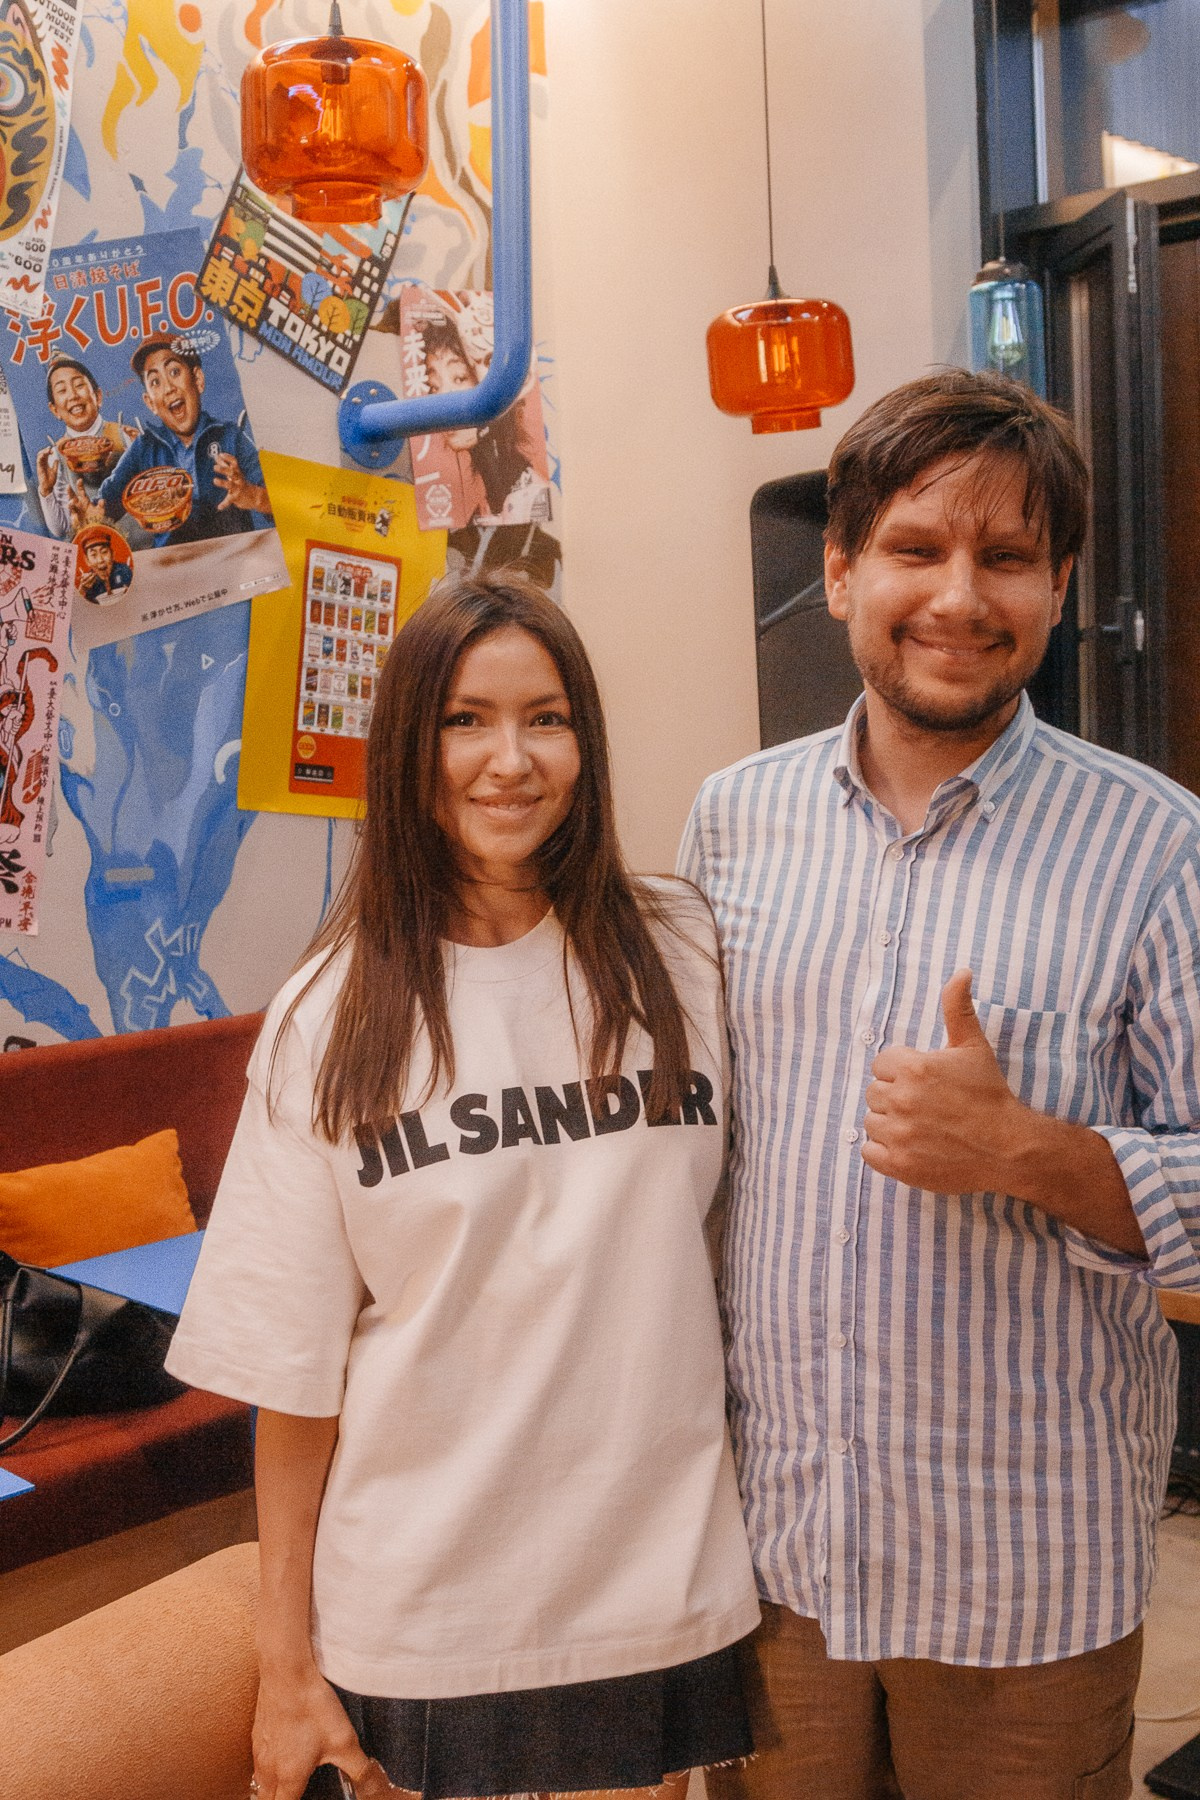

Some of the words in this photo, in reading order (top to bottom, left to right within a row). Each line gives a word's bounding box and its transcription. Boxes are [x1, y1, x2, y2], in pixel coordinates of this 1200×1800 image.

[34, 0, 76, 25] UTDOOR
[45, 13, 74, 36] MUSIC
[48, 25, 72, 47] FEST.
[25, 241, 46, 253] 500
[14, 255, 42, 273] 600
[53, 259, 141, 290] 日清焼そば
[200, 255, 267, 329] 東京
[267, 297, 352, 377] TOKYO
[258, 320, 293, 354] MON
[291, 345, 344, 390] AMOUR
[131, 474, 184, 495] UFO
[353, 1109, 451, 1188] JIL
